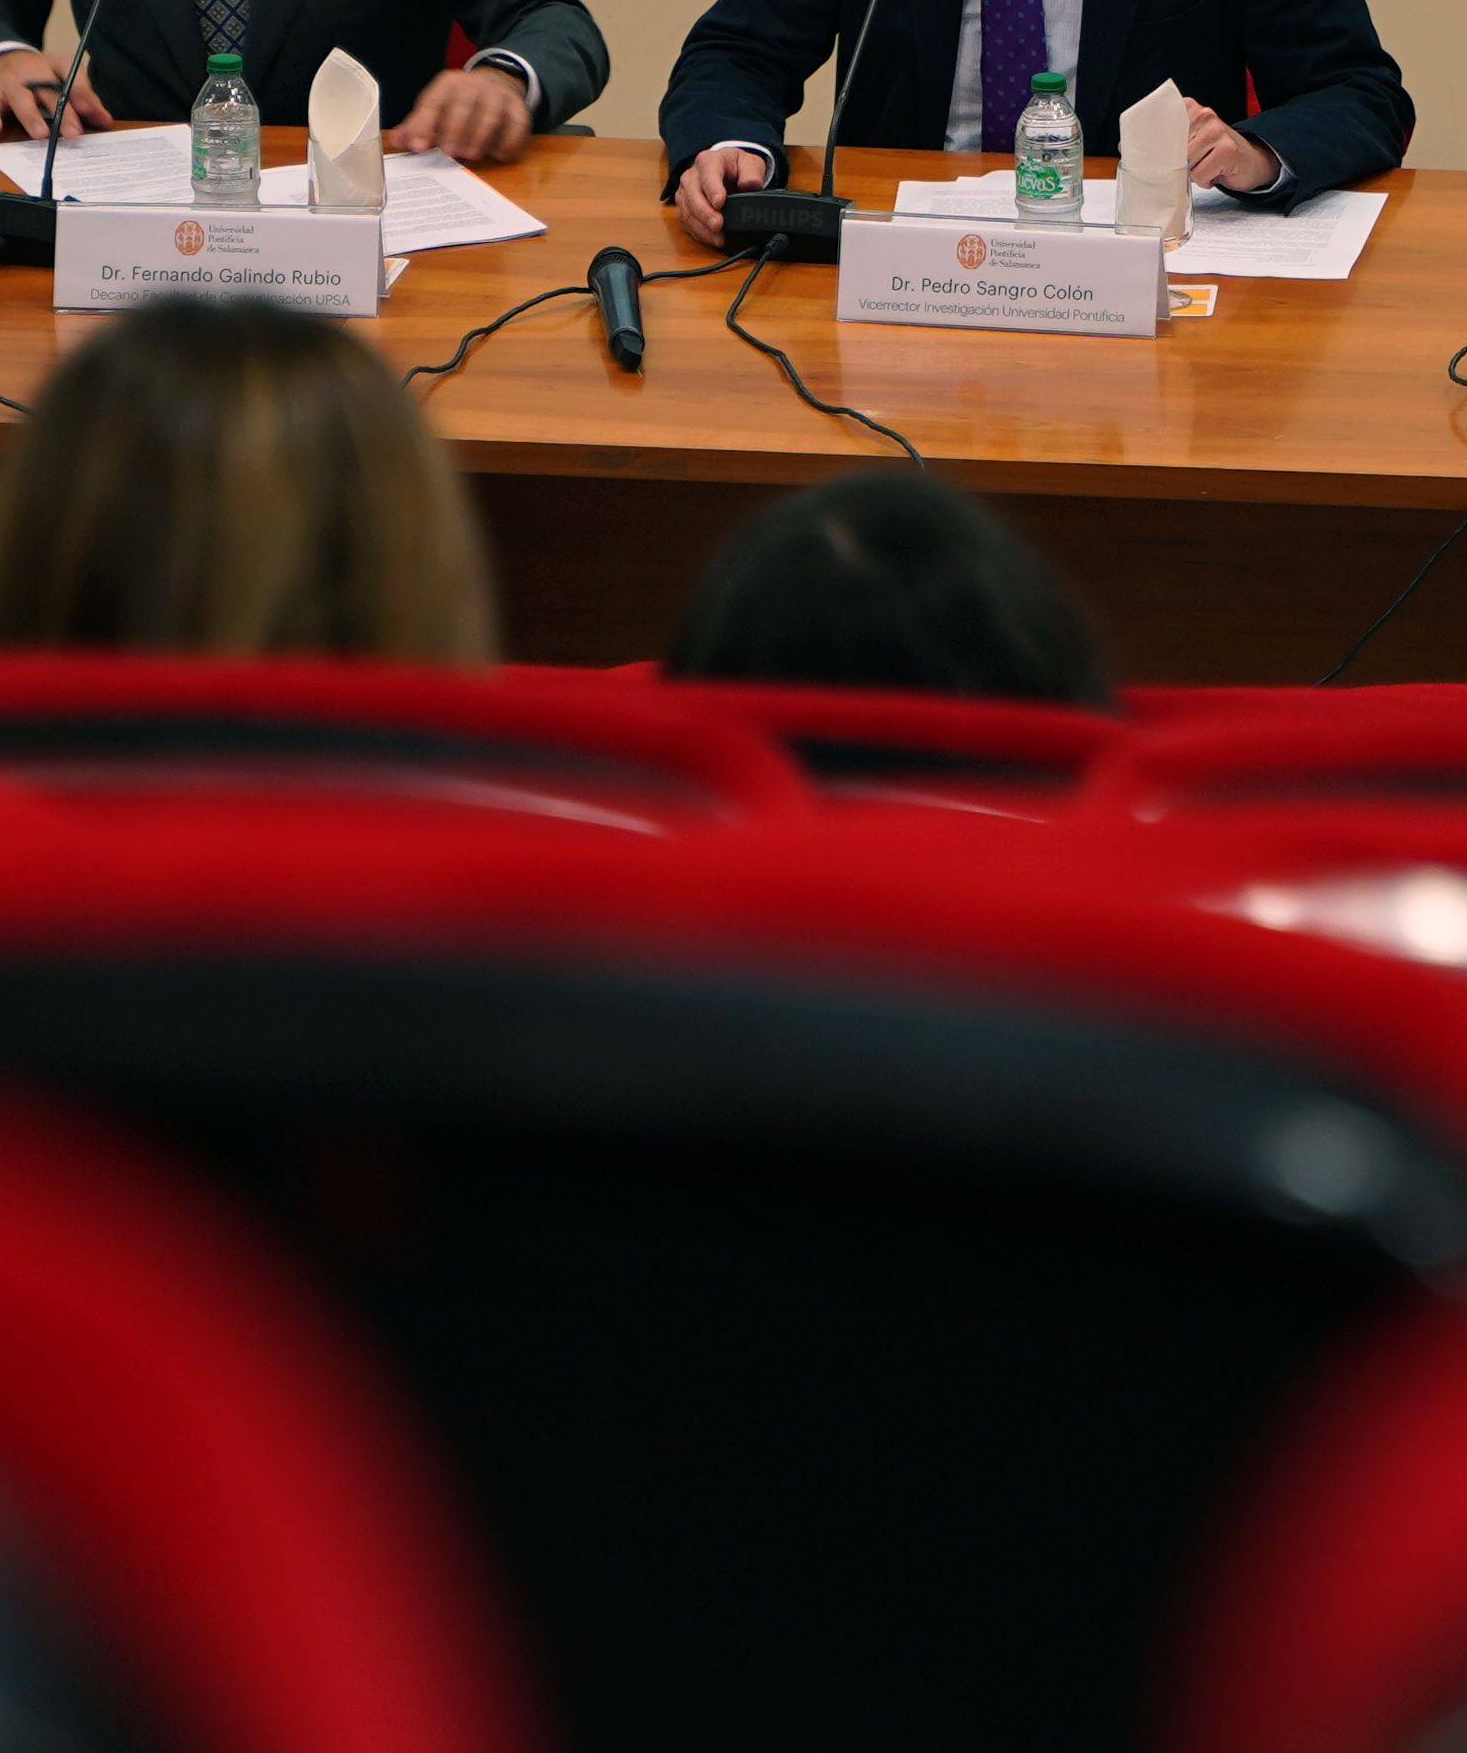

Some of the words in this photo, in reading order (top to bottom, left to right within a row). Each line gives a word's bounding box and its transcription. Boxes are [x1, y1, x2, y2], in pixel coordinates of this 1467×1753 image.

[740, 205, 824, 229] PHILIPS
[101, 265, 125, 281] Dr.
[132, 266, 213, 283] Fernando
[219, 267, 286, 285] Galindo
[293, 270, 341, 286] Rubio
[90, 288, 138, 302] Decano
[315, 293, 351, 307] UPSA
[891, 276, 914, 292] Dr.
[922, 277, 971, 296] Pedro
[976, 280, 1037, 300] Sangro
[1043, 284, 1094, 302] Colón
[858, 298, 920, 313] Vicerrector
[924, 301, 999, 318] Investigación
[1002, 305, 1069, 320] Universidad
[1073, 308, 1125, 324] Pontificia
